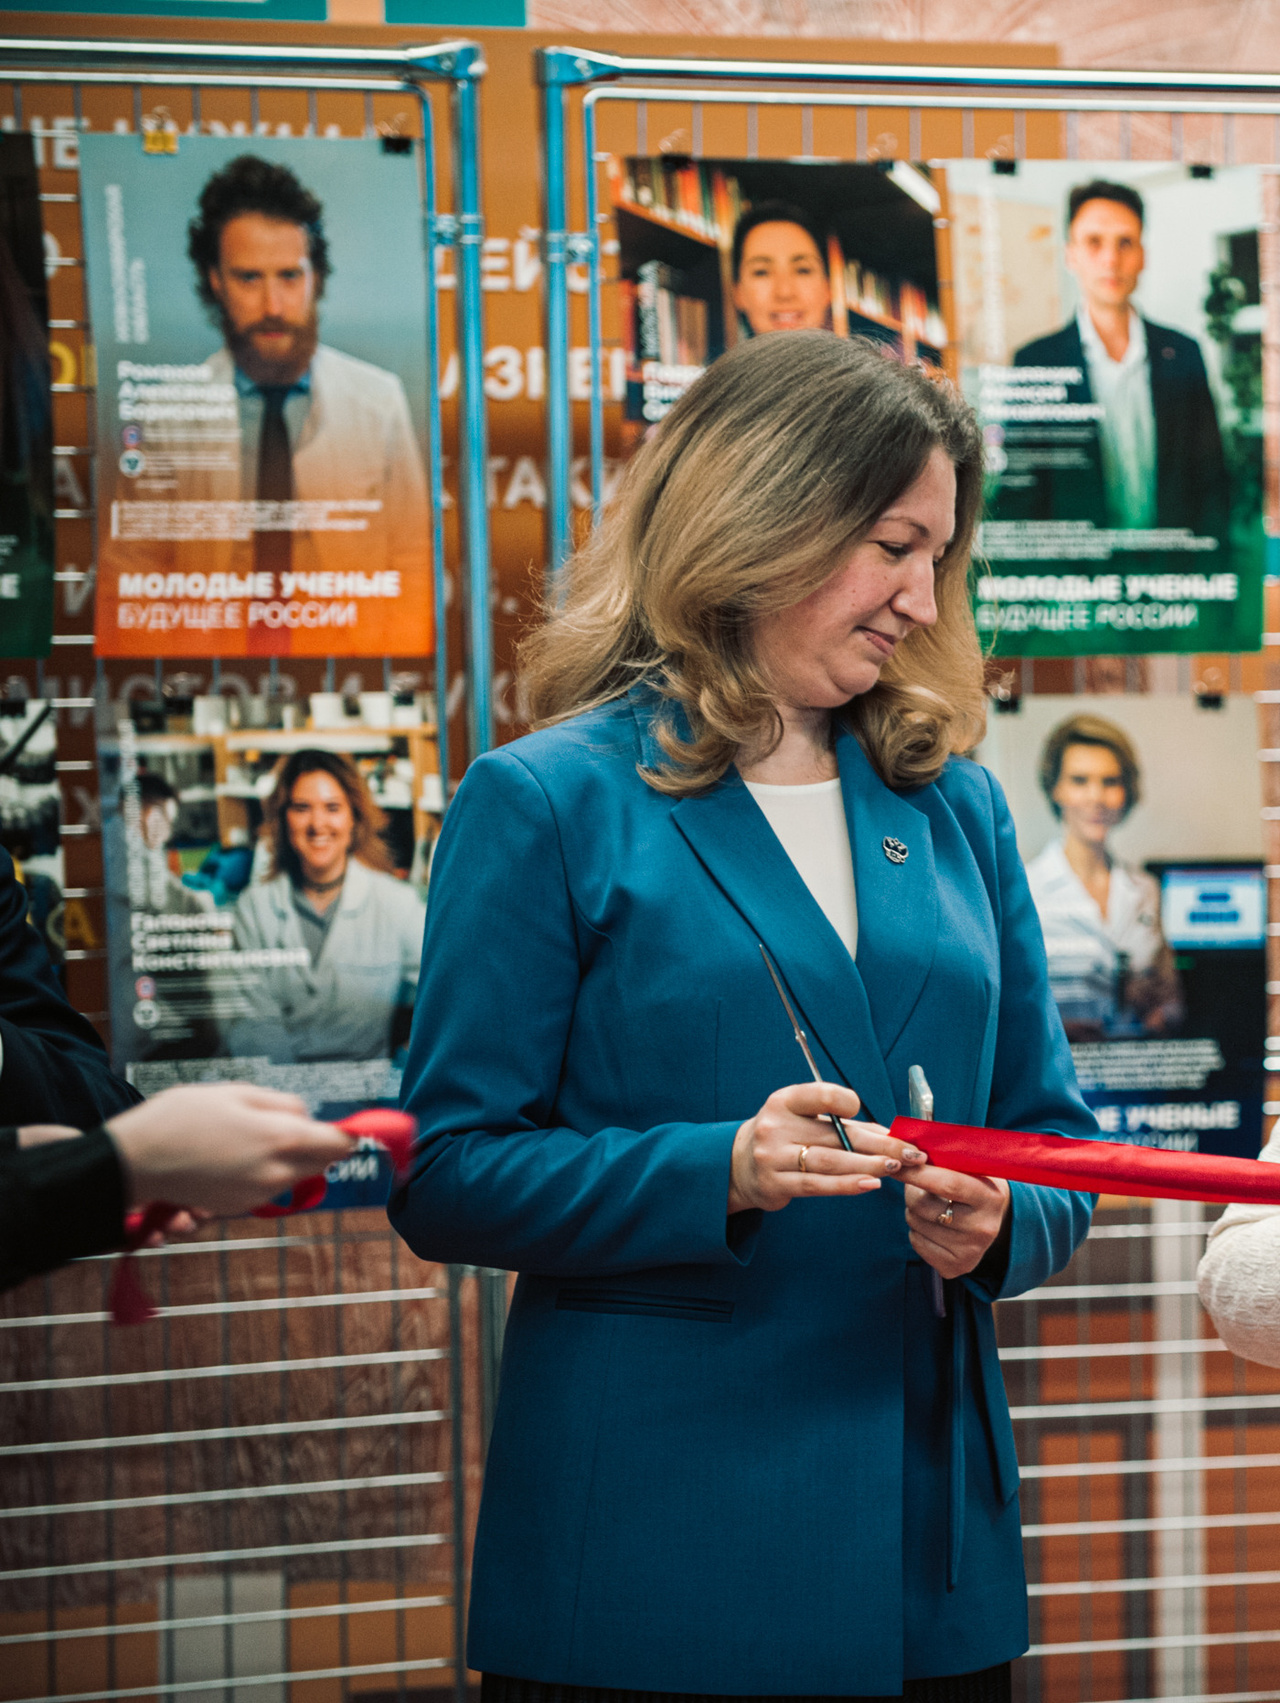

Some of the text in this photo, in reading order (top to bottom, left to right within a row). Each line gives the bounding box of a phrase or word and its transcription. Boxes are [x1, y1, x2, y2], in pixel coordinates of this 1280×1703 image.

[118, 571, 401, 601] МОЛОДЫЕ УЧЕНЫЕ
[977, 573, 1238, 601] МОЛОДЫЕ УЧЕНЫЕ
[117, 601, 358, 631] БУДУЩЕЕ РОССИИ
[976, 602, 1198, 632] БУДУЩЕЕ РОССИИ
[1125, 1101, 1241, 1132] УЧЕНЫЕ
